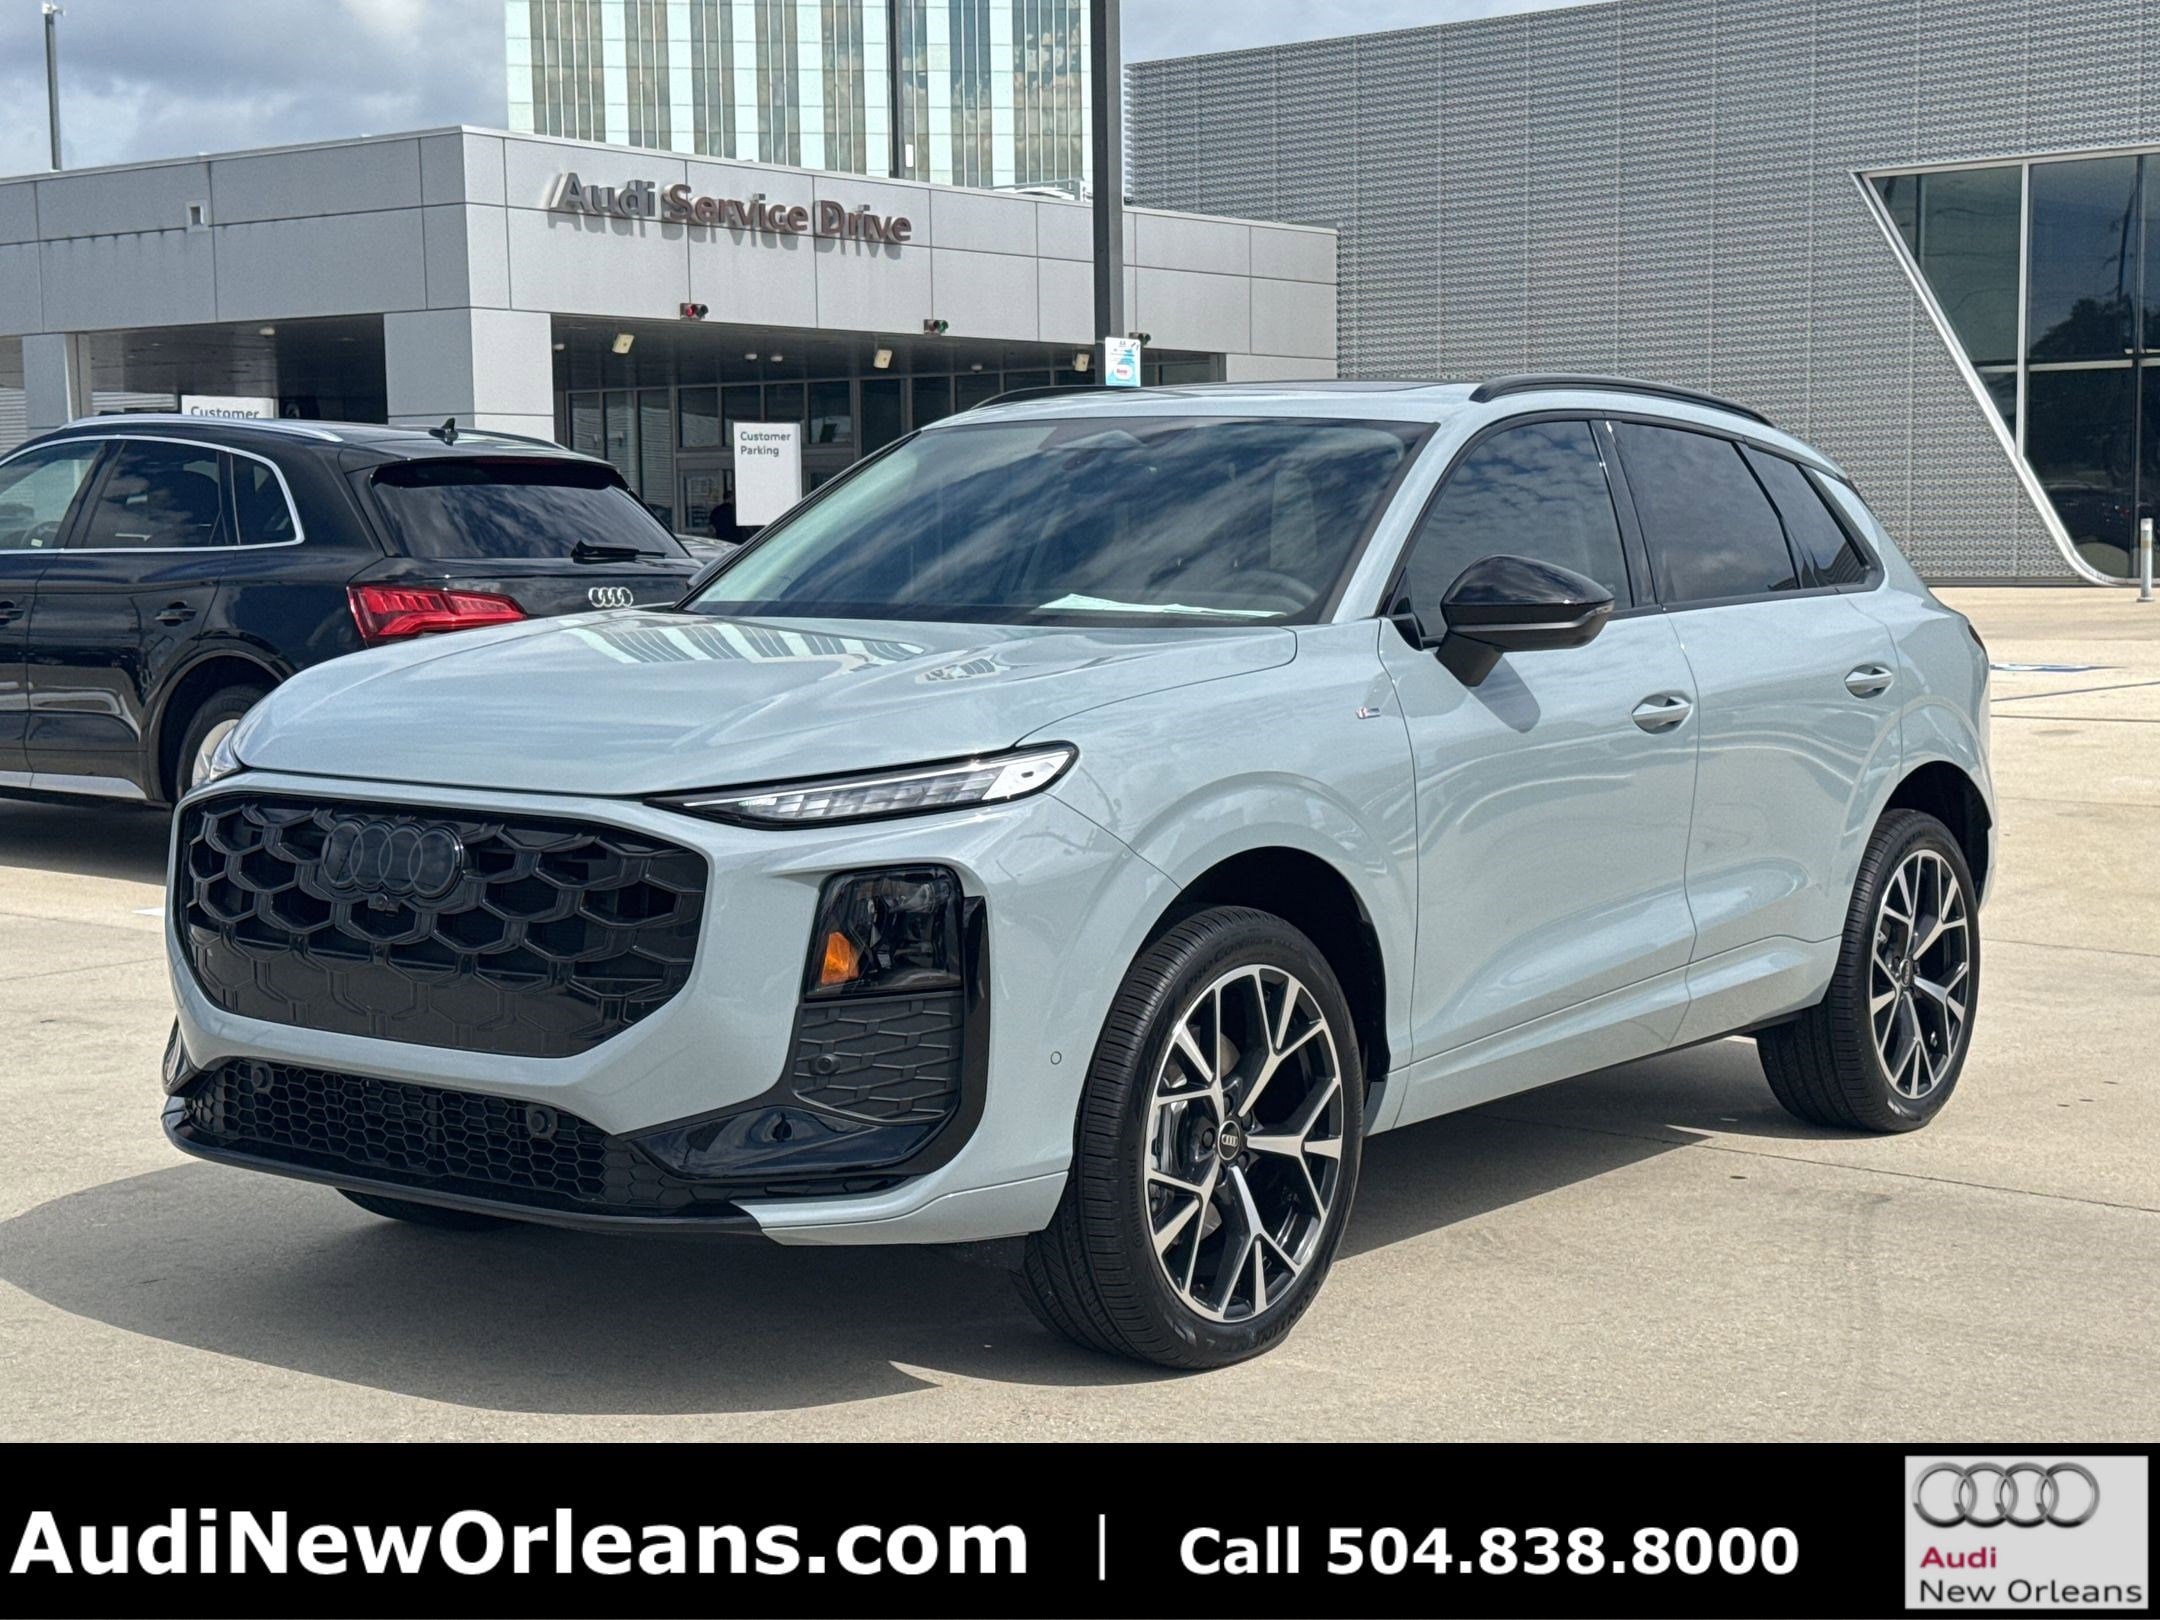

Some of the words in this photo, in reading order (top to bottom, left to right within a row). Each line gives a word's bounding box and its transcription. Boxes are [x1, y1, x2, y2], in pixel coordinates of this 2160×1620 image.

[550, 171, 656, 218] Audi
[661, 184, 809, 233] Service
[814, 199, 912, 243] Drive
[190, 406, 260, 419] Customer
[740, 430, 791, 442] Customer
[740, 446, 780, 457] Parking
